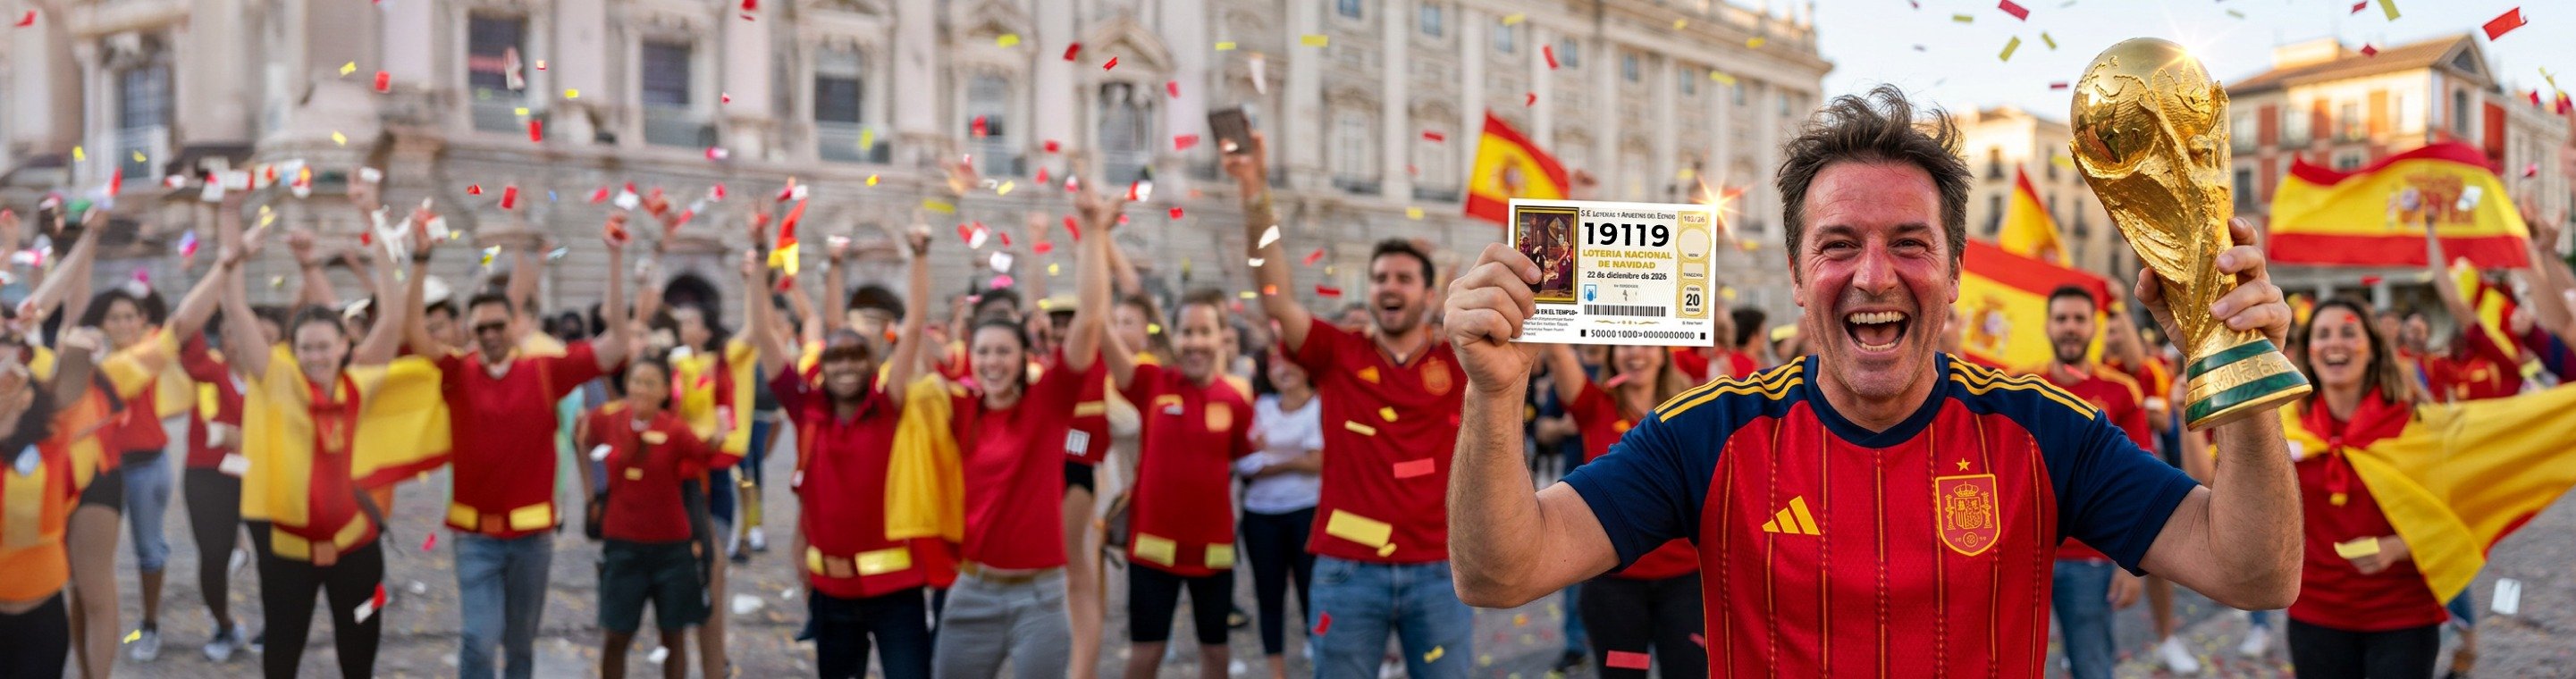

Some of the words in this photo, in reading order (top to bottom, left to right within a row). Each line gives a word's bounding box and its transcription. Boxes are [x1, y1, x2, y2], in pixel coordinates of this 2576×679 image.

[1584, 222, 1670, 247] 19119
[1583, 248, 1622, 258] LOTERIA
[1624, 250, 1672, 259] NACIONAL
[1598, 260, 1611, 268] DE
[1612, 260, 1656, 269] NAVIDAD
[1587, 271, 1595, 279] 22
[1686, 293, 1700, 306] 20
